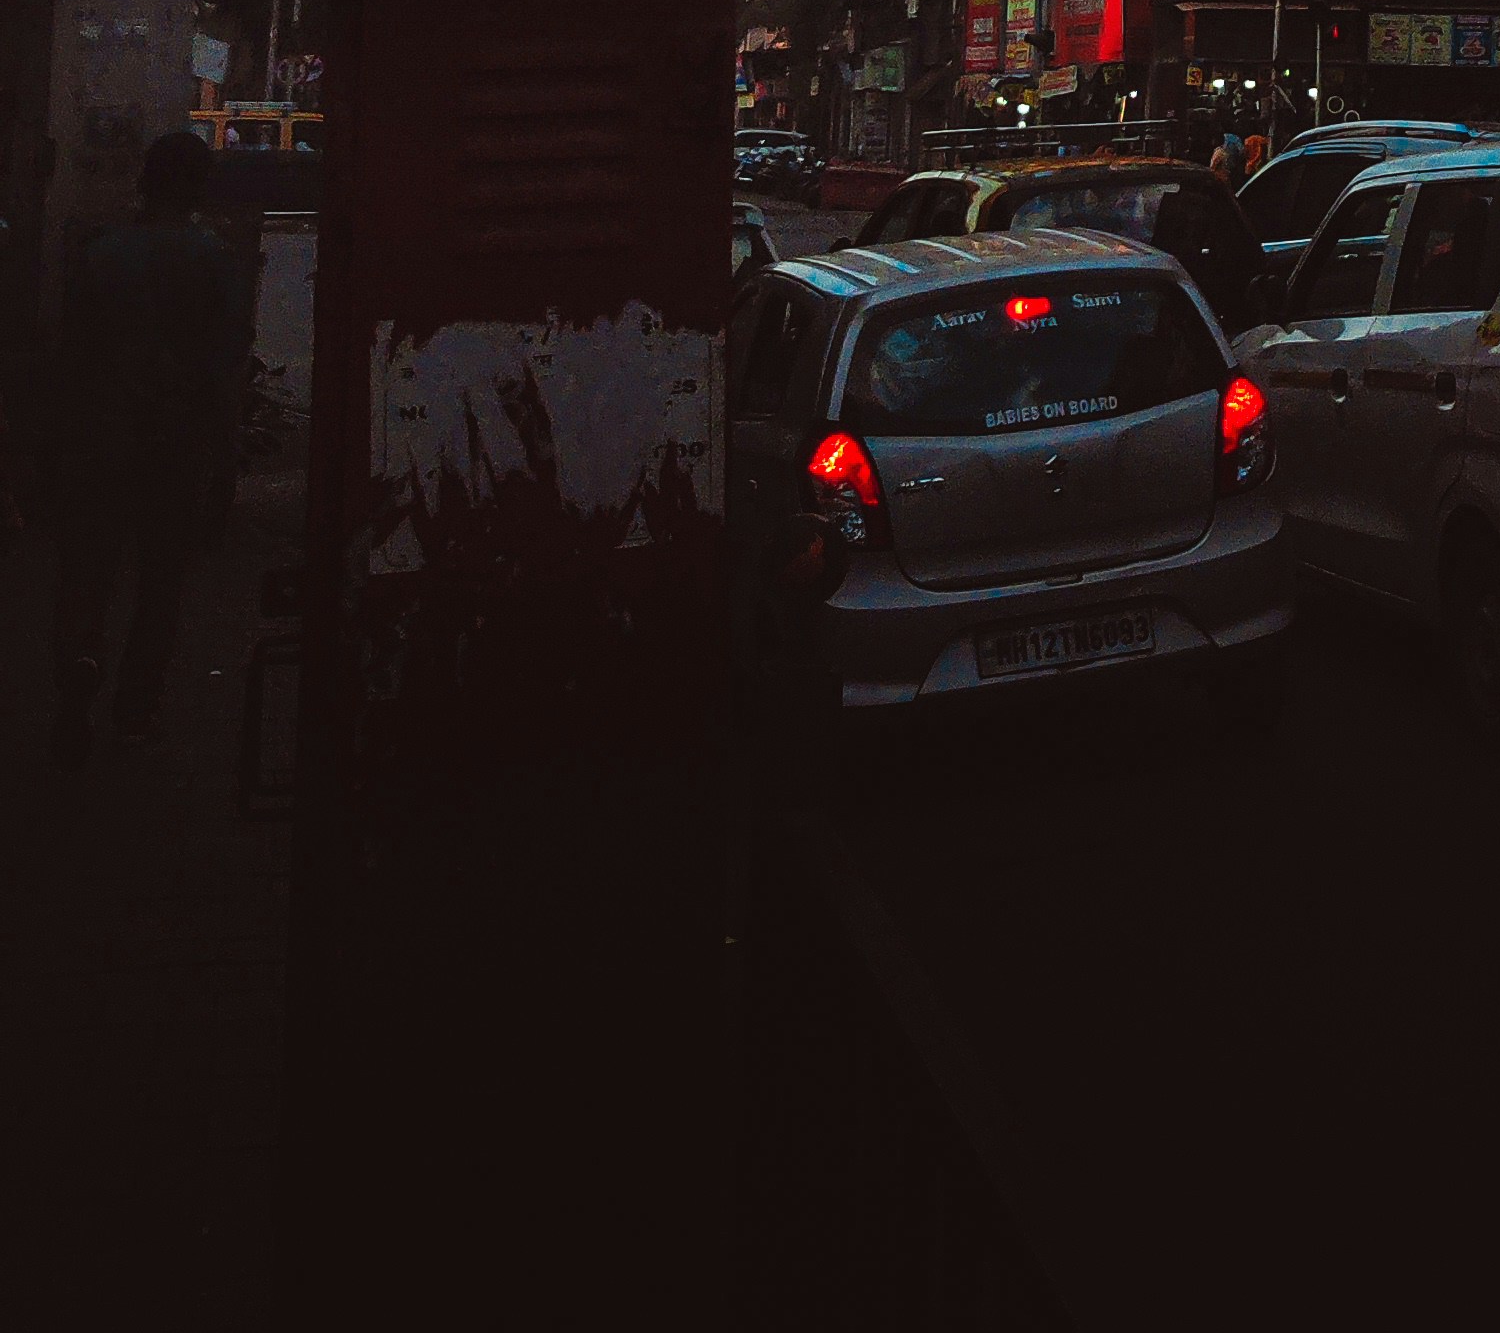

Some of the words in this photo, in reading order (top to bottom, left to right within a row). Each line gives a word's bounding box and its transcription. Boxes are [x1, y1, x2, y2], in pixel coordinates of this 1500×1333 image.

[931, 310, 988, 331] Aarav
[985, 406, 1041, 428] BABIES
[1043, 401, 1067, 419] ON
[1069, 395, 1119, 416] BOARD
